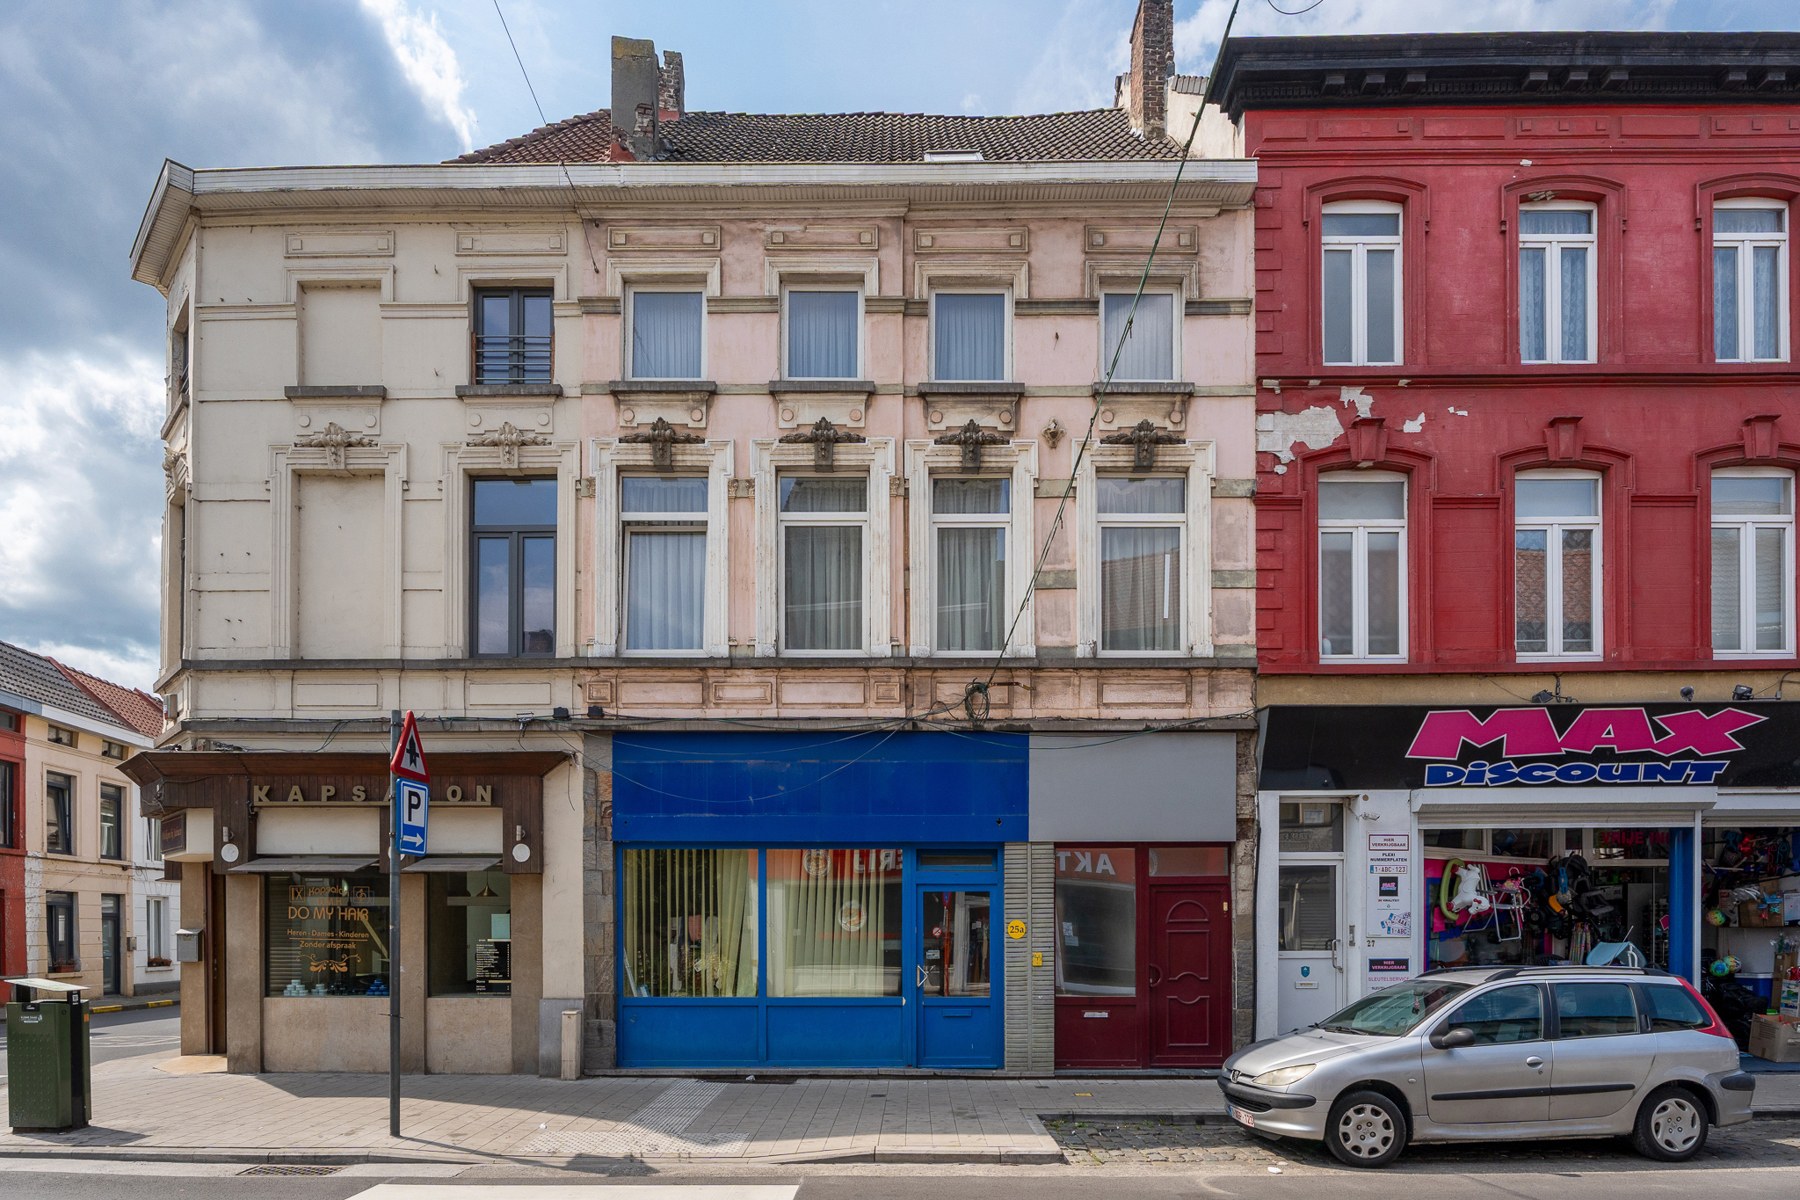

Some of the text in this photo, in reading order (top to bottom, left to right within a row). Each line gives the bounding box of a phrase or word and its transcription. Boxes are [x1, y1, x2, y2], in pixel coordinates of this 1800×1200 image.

[1404, 707, 1769, 760] MAX
[253, 785, 492, 802] KAPSON
[408, 791, 421, 822] P
[1601, 831, 1644, 844] VRIJE
[308, 885, 350, 897] Kapsalon
[288, 906, 369, 921] DO MY HAIR
[1009, 925, 1025, 934] 25a
[326, 941, 357, 950] afspraak
